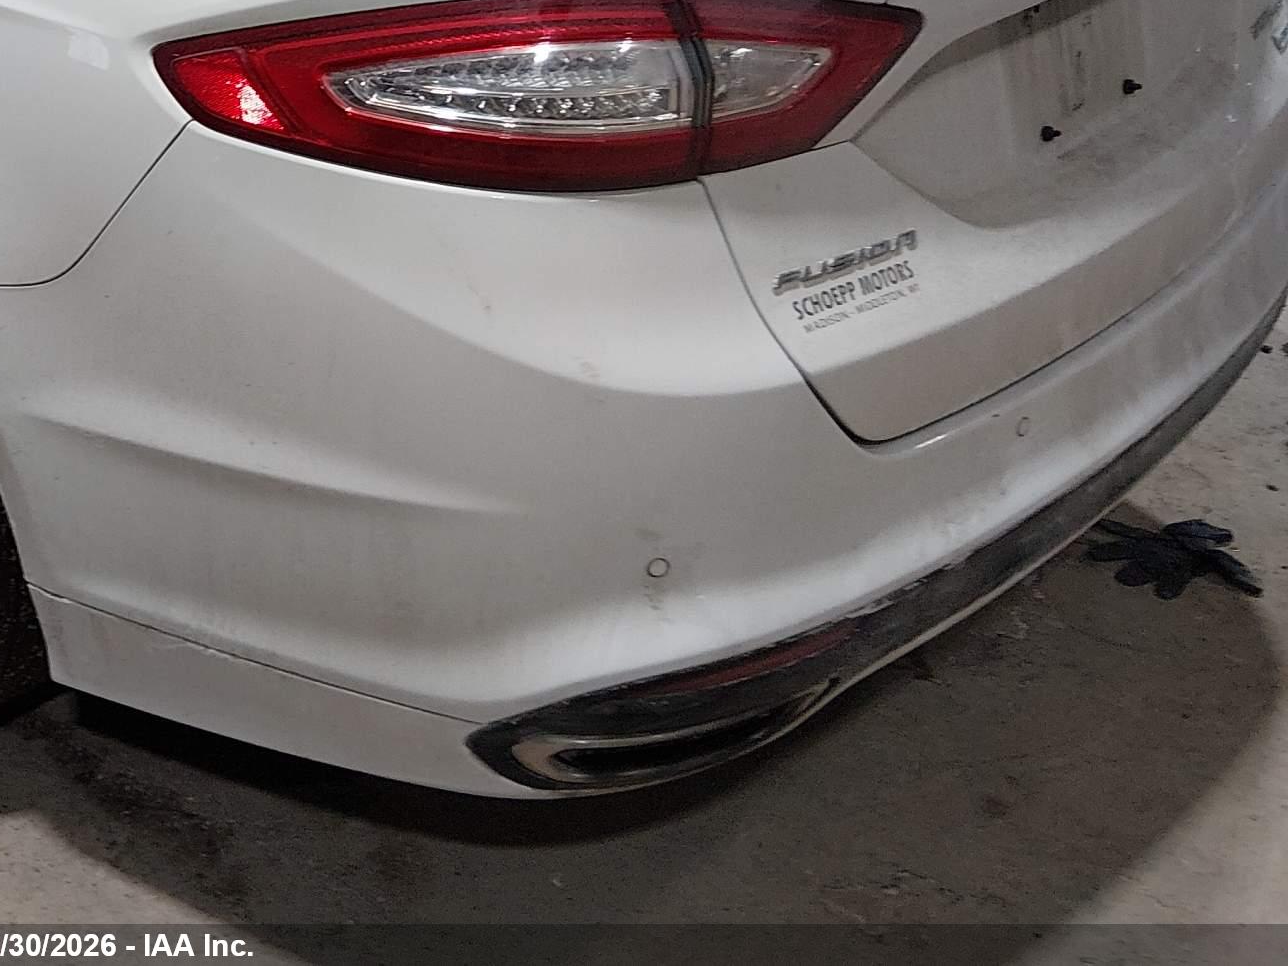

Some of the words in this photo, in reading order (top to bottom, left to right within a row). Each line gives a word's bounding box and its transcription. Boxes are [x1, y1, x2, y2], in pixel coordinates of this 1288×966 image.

[772, 228, 918, 295] FUSION
[792, 281, 856, 320] SCHOEPP
[857, 260, 915, 296] MOTORS
